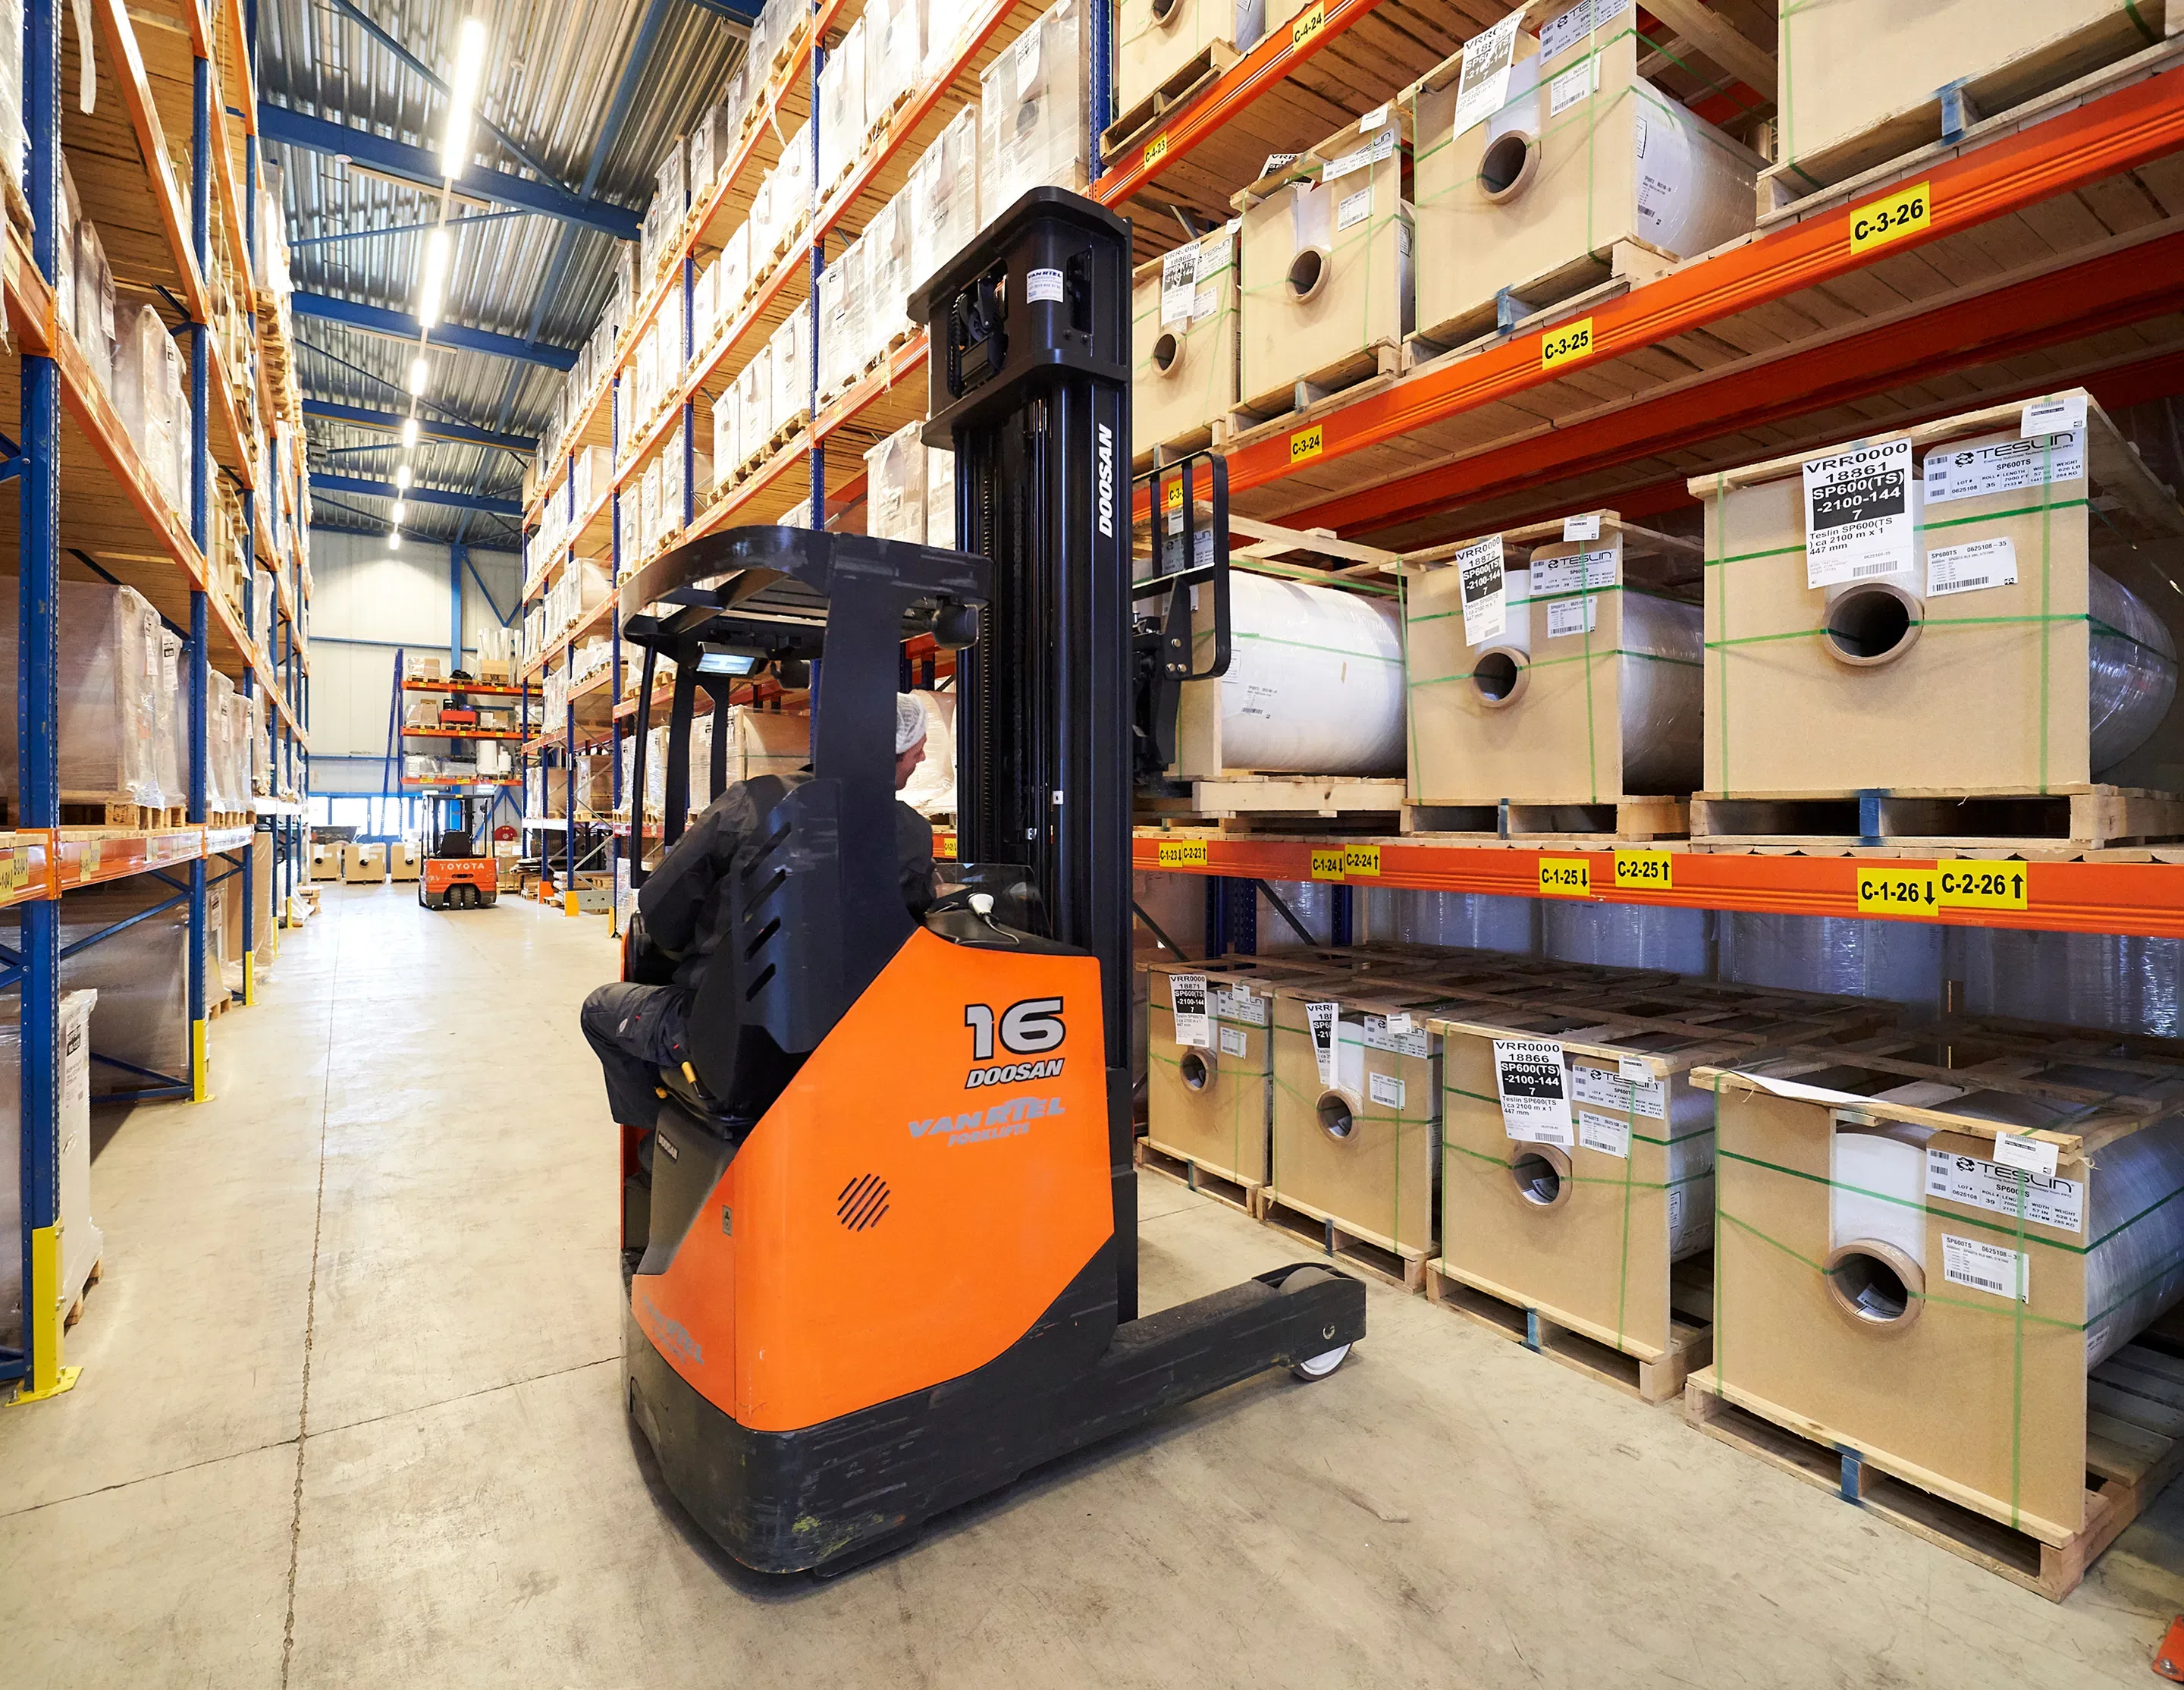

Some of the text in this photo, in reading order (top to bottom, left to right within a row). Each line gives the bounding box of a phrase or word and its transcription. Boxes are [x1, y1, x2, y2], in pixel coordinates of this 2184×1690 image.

[1294, 12, 1322, 42] C-4-24
[1145, 140, 1166, 163] C-4-23
[1855, 198, 1924, 240] C-3-26
[1545, 330, 1588, 360] C-3-25
[1293, 435, 1320, 455] C-3-24
[1977, 432, 2074, 458] TESLIN
[1806, 443, 1907, 473] VRR0000
[1997, 459, 2031, 470] SP600TS
[1099, 422, 1112, 538] DOOSAN
[1825, 461, 1886, 483] 18861
[1169, 488, 1183, 501] C-3-
[1813, 471, 1904, 500] SP600(TS)
[1952, 485, 1978, 494] 0625108
[1817, 486, 1901, 513] -2100-144
[1853, 509, 1862, 520] 7
[1809, 517, 1893, 540] Teslin SP600(TS
[1830, 533, 1853, 544] 2100
[1458, 537, 1500, 561] VRR0000
[1560, 551, 1612, 565] TESLIN
[1809, 543, 1847, 555] 447 mm
[1931, 549, 1957, 559] SP600TS
[1967, 543, 1992, 552] 0625108
[1469, 551, 1495, 567] 18872
[1463, 557, 1501, 580] SP600(TS)
[1467, 570, 1501, 589] -2100-144
[1483, 587, 1487, 595] 7
[1160, 849, 1177, 861] C-1-23
[1184, 847, 1202, 859] C-2-23
[1346, 853, 1372, 867] C-2-24
[1313, 858, 1337, 872] C-1-24
[1618, 861, 1658, 878] C-2-25
[1542, 868, 1577, 885] C-1-25
[1941, 873, 2006, 895] C-2-26
[1861, 881, 1919, 902] C-1-26
[965, 996, 1066, 1061] 16
[1496, 1042, 1560, 1052] VRR0000
[1509, 1054, 1549, 1063] 18866
[965, 1058, 1065, 1089] DOOSAN
[1502, 1063, 1560, 1076] SP600(TS)
[1505, 1075, 1559, 1085] -2100-144
[1529, 1087, 1536, 1095] 7
[1614, 1088, 1633, 1096] SP600T
[908, 1097, 1066, 1139] VAN RIEL
[948, 1123, 1030, 1147] FORKLIFTS
[1977, 1161, 2071, 1193] TESLIN
[1952, 1190, 1978, 1200] 0625108
[1947, 1237, 2007, 1257] SP600TS 0625108
